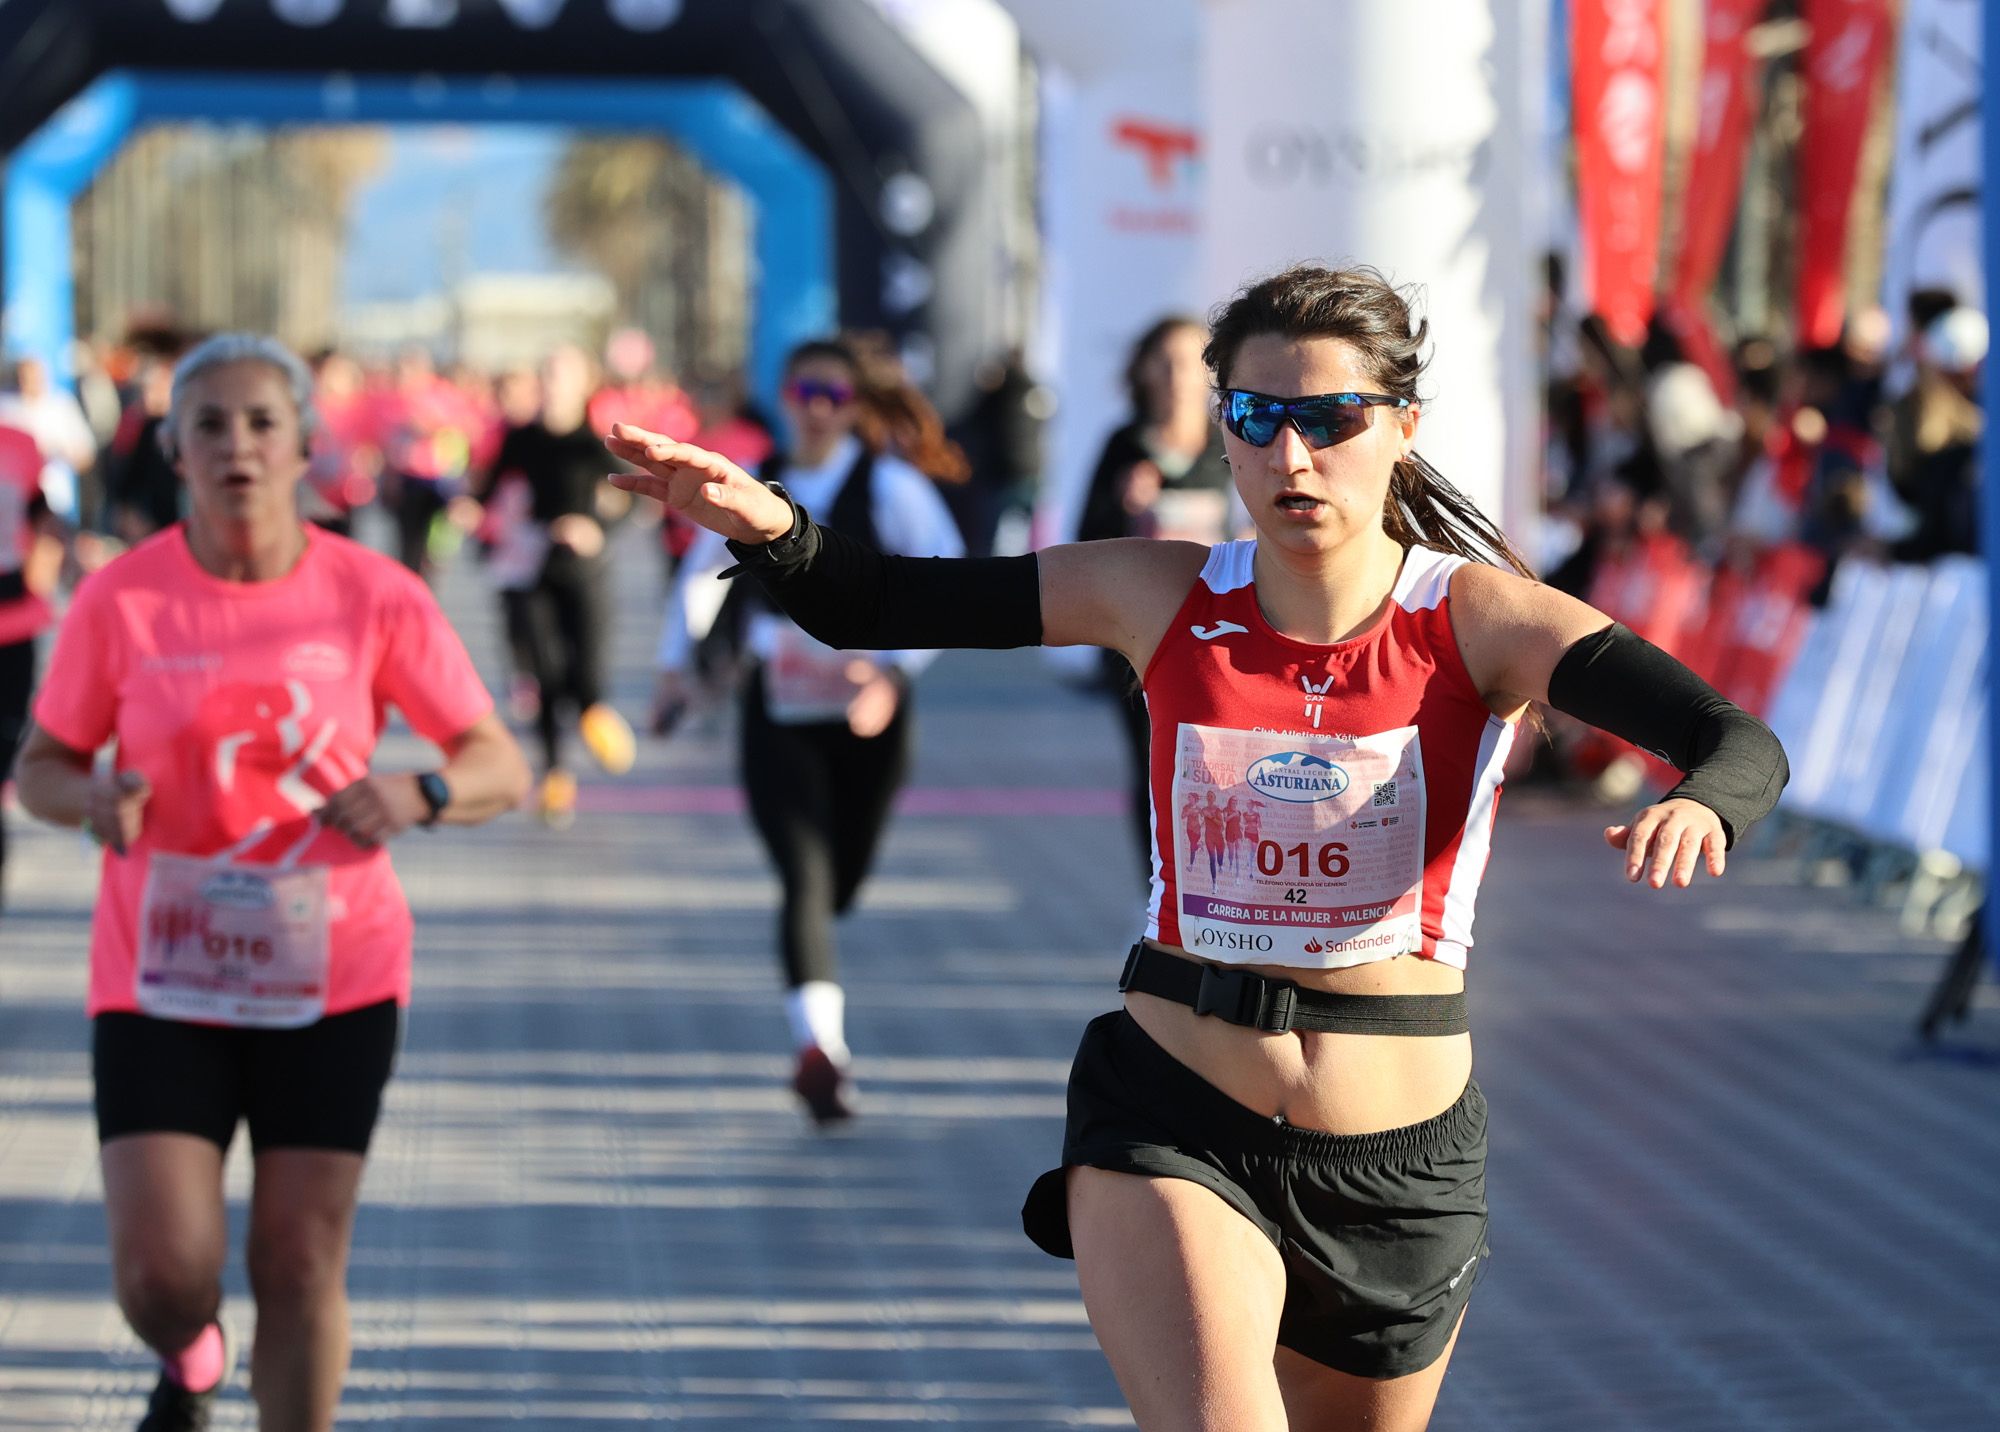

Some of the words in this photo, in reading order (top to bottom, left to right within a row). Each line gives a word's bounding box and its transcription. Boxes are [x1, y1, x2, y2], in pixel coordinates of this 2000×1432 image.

[1305, 694, 1326, 702] CAX
[1192, 769, 1236, 786] SUMA
[1254, 766, 1341, 791] ASTURIANA
[1256, 839, 1350, 878] 016
[1284, 888, 1307, 904] 42
[1207, 902, 1251, 920] CARRERA
[1254, 909, 1270, 921] DE
[1272, 910, 1288, 922] LA
[1291, 911, 1331, 923] MUJER
[1341, 905, 1394, 922] VALENCIA
[1201, 927, 1273, 952] OYSHO
[1325, 933, 1396, 954] Santander
